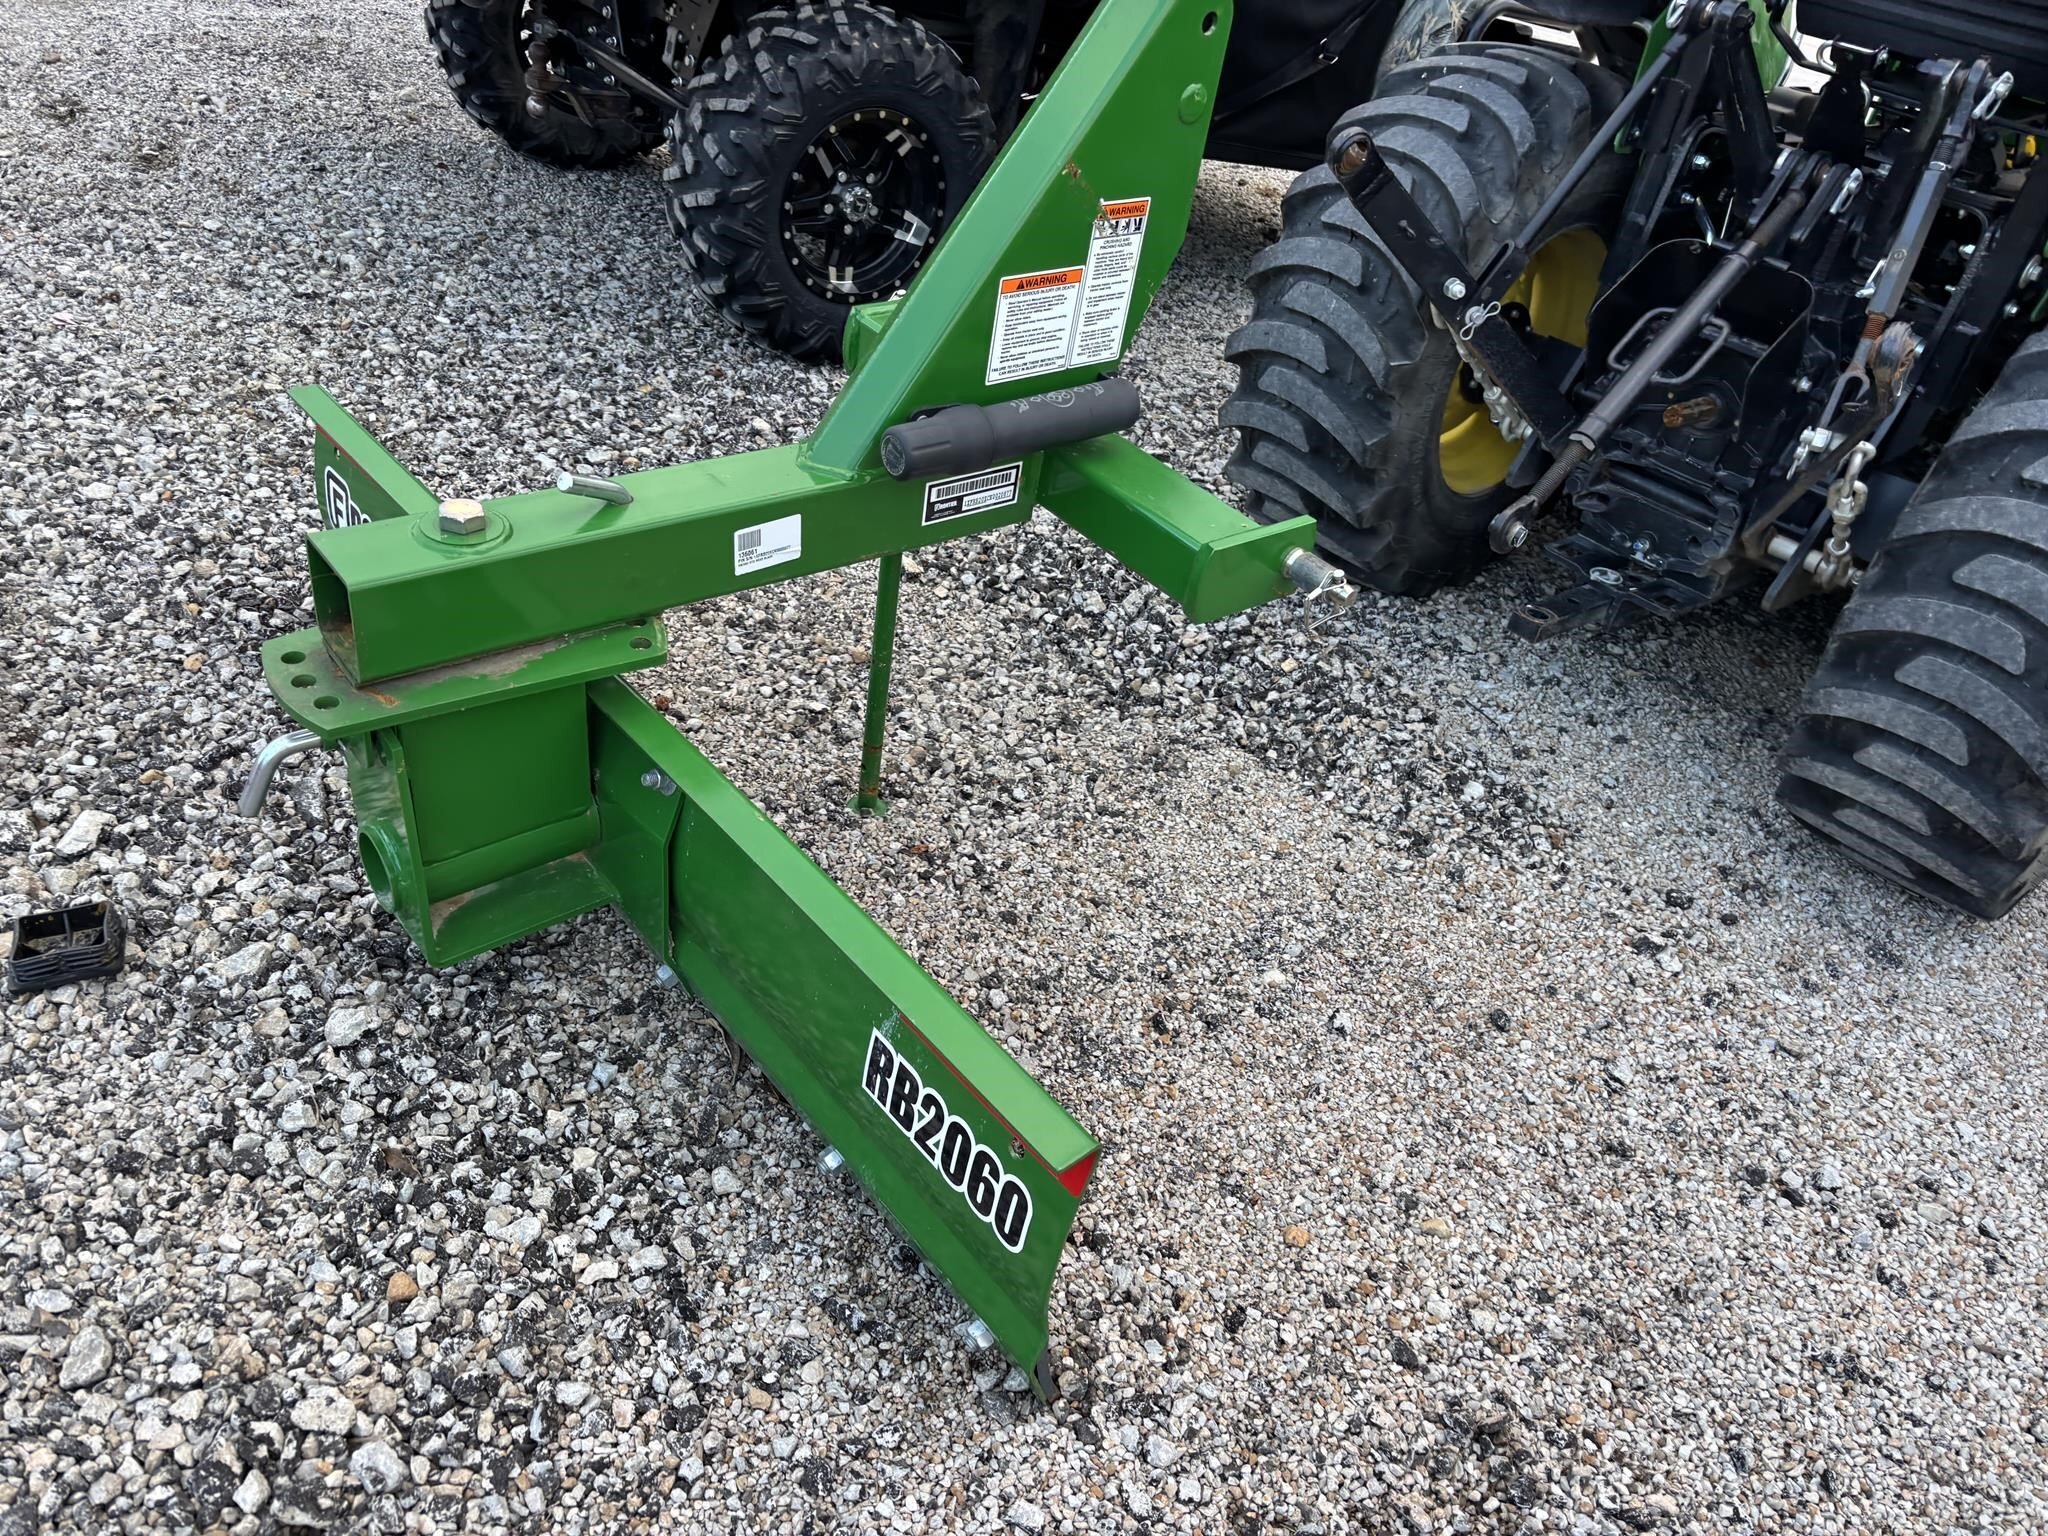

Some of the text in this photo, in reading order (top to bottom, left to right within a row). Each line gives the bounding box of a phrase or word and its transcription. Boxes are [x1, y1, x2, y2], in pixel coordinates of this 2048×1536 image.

[1108, 204, 1145, 217] WARNING
[1025, 274, 1067, 288] WARNING
[863, 1030, 1031, 1252] RB2060
